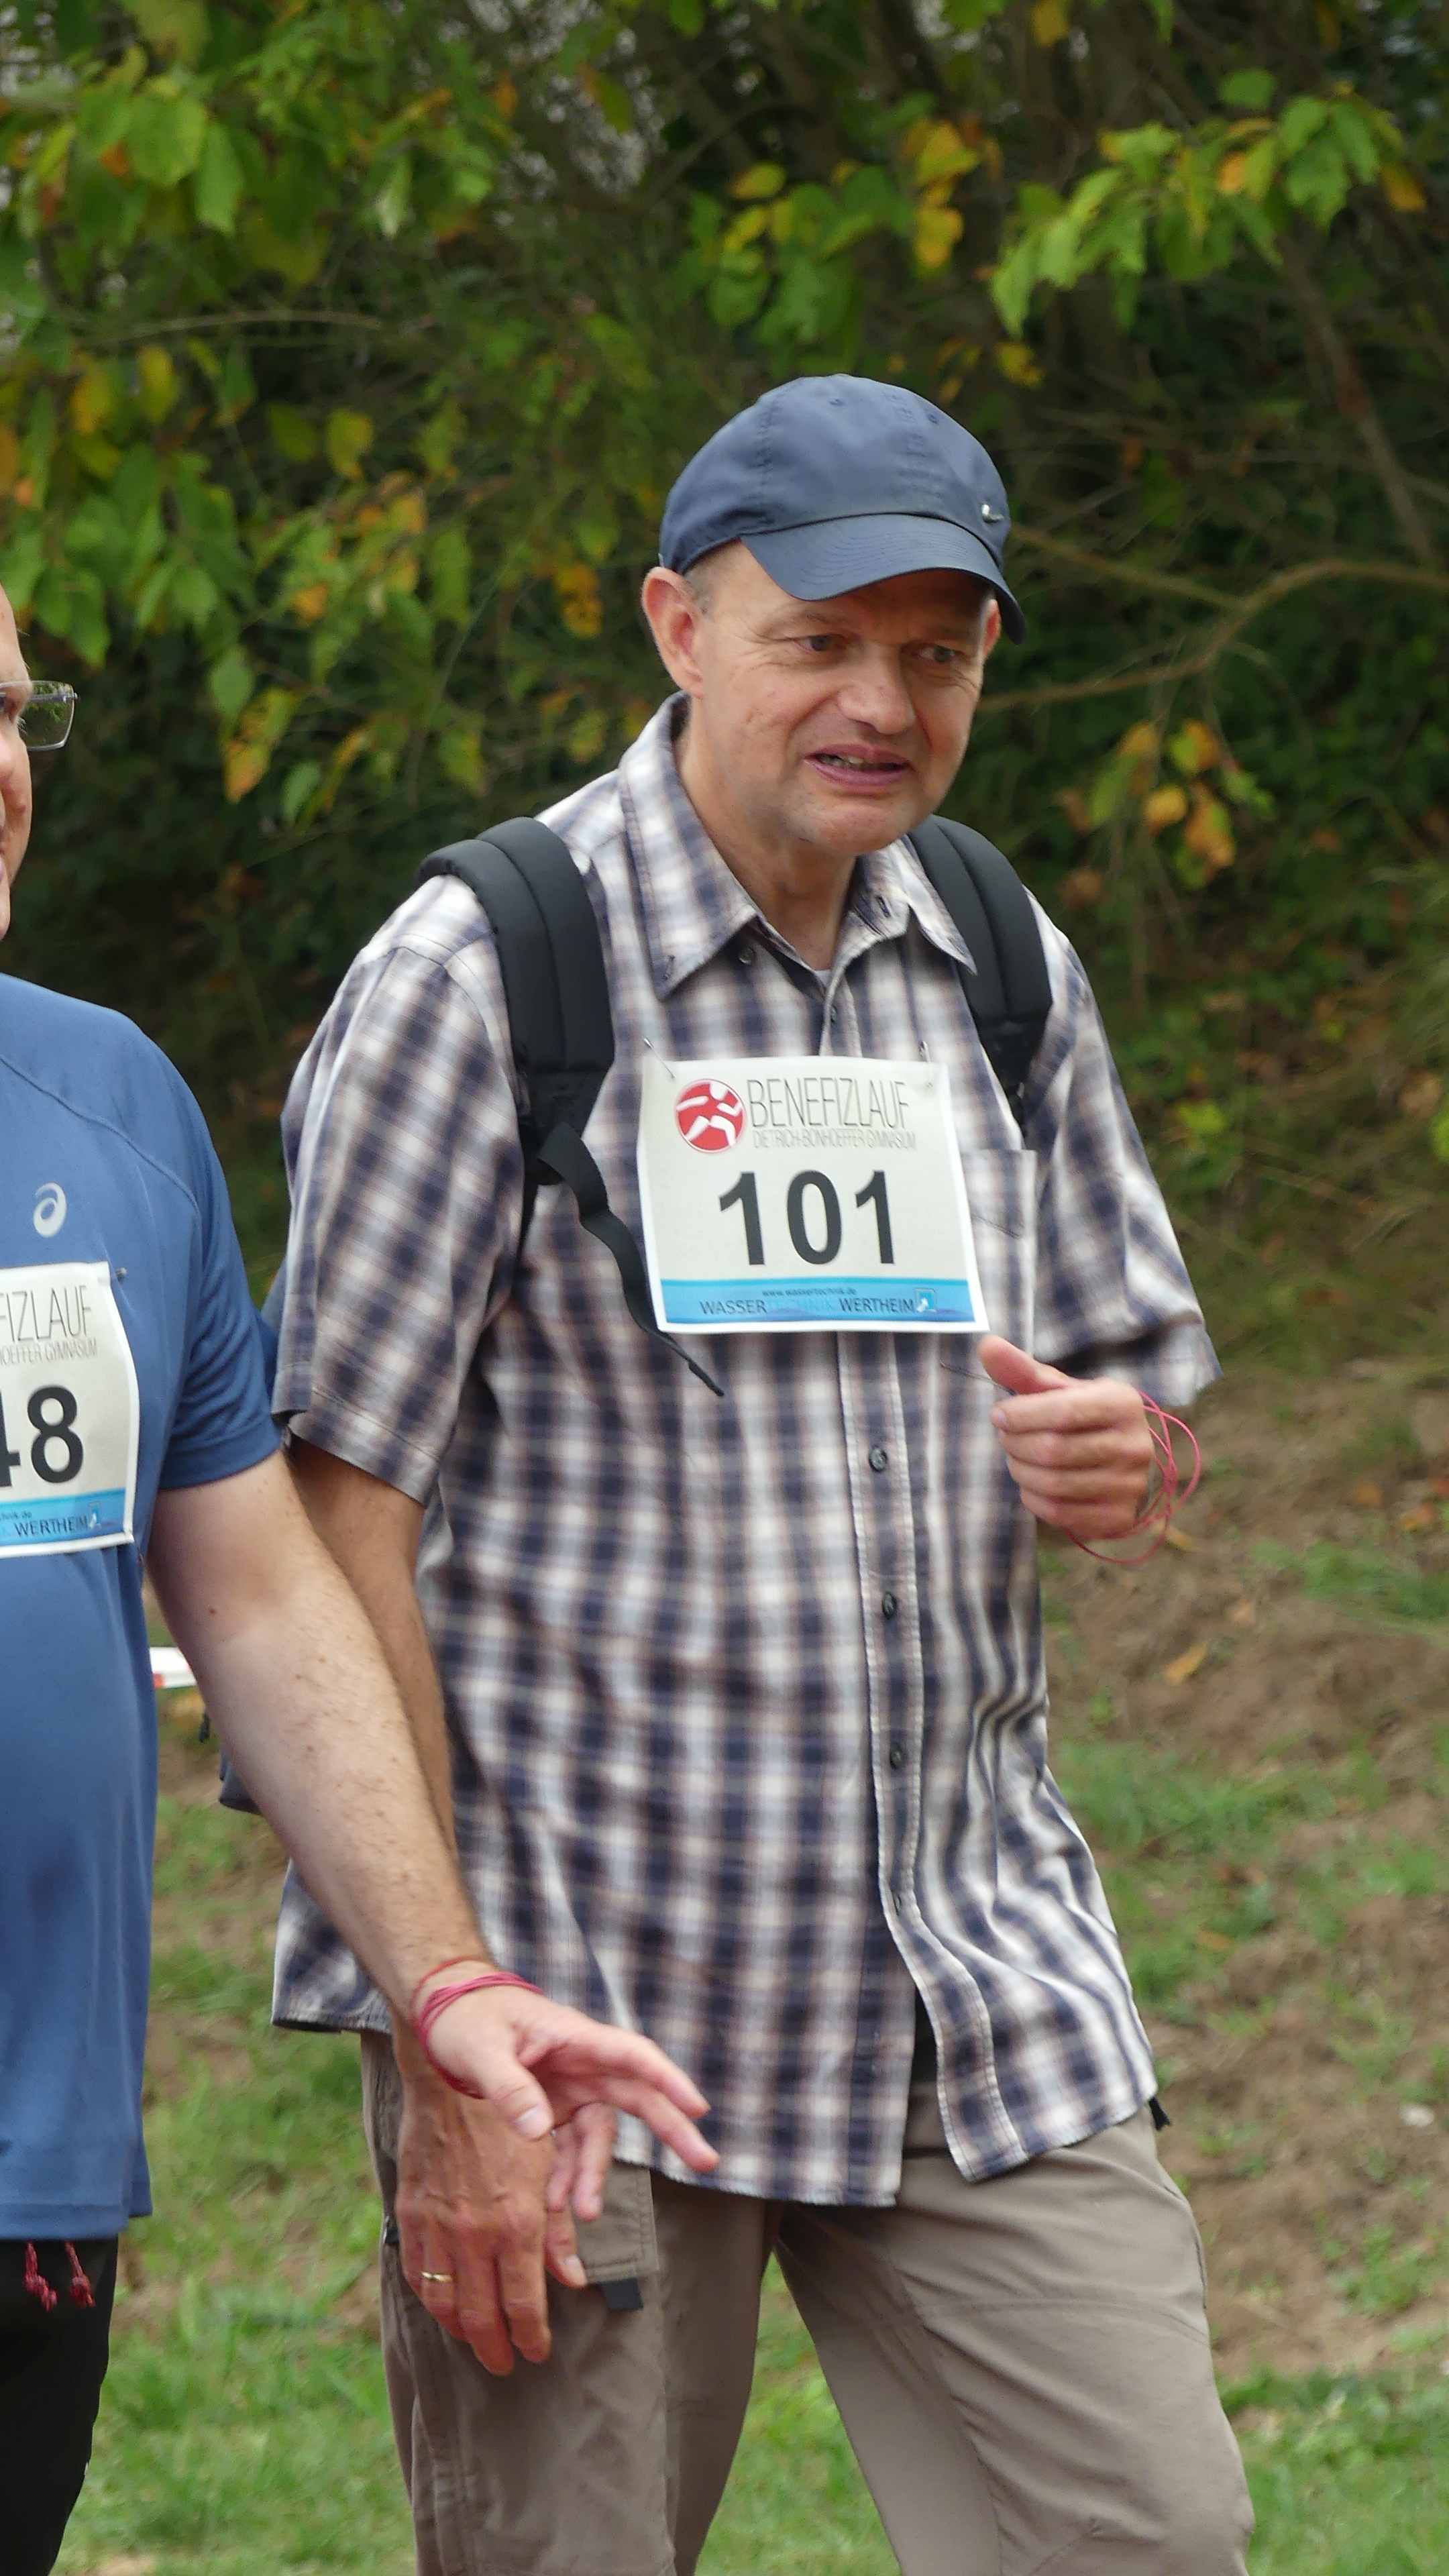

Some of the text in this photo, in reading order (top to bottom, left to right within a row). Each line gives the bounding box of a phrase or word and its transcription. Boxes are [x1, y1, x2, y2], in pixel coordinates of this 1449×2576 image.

[746, 1076, 909, 1128] BENEFIZLAUF
[718, 1169, 895, 1266] 101
[839, 1297, 915, 1313] WERTHEIM
[13, 1515, 89, 1537] WERTHEIM
